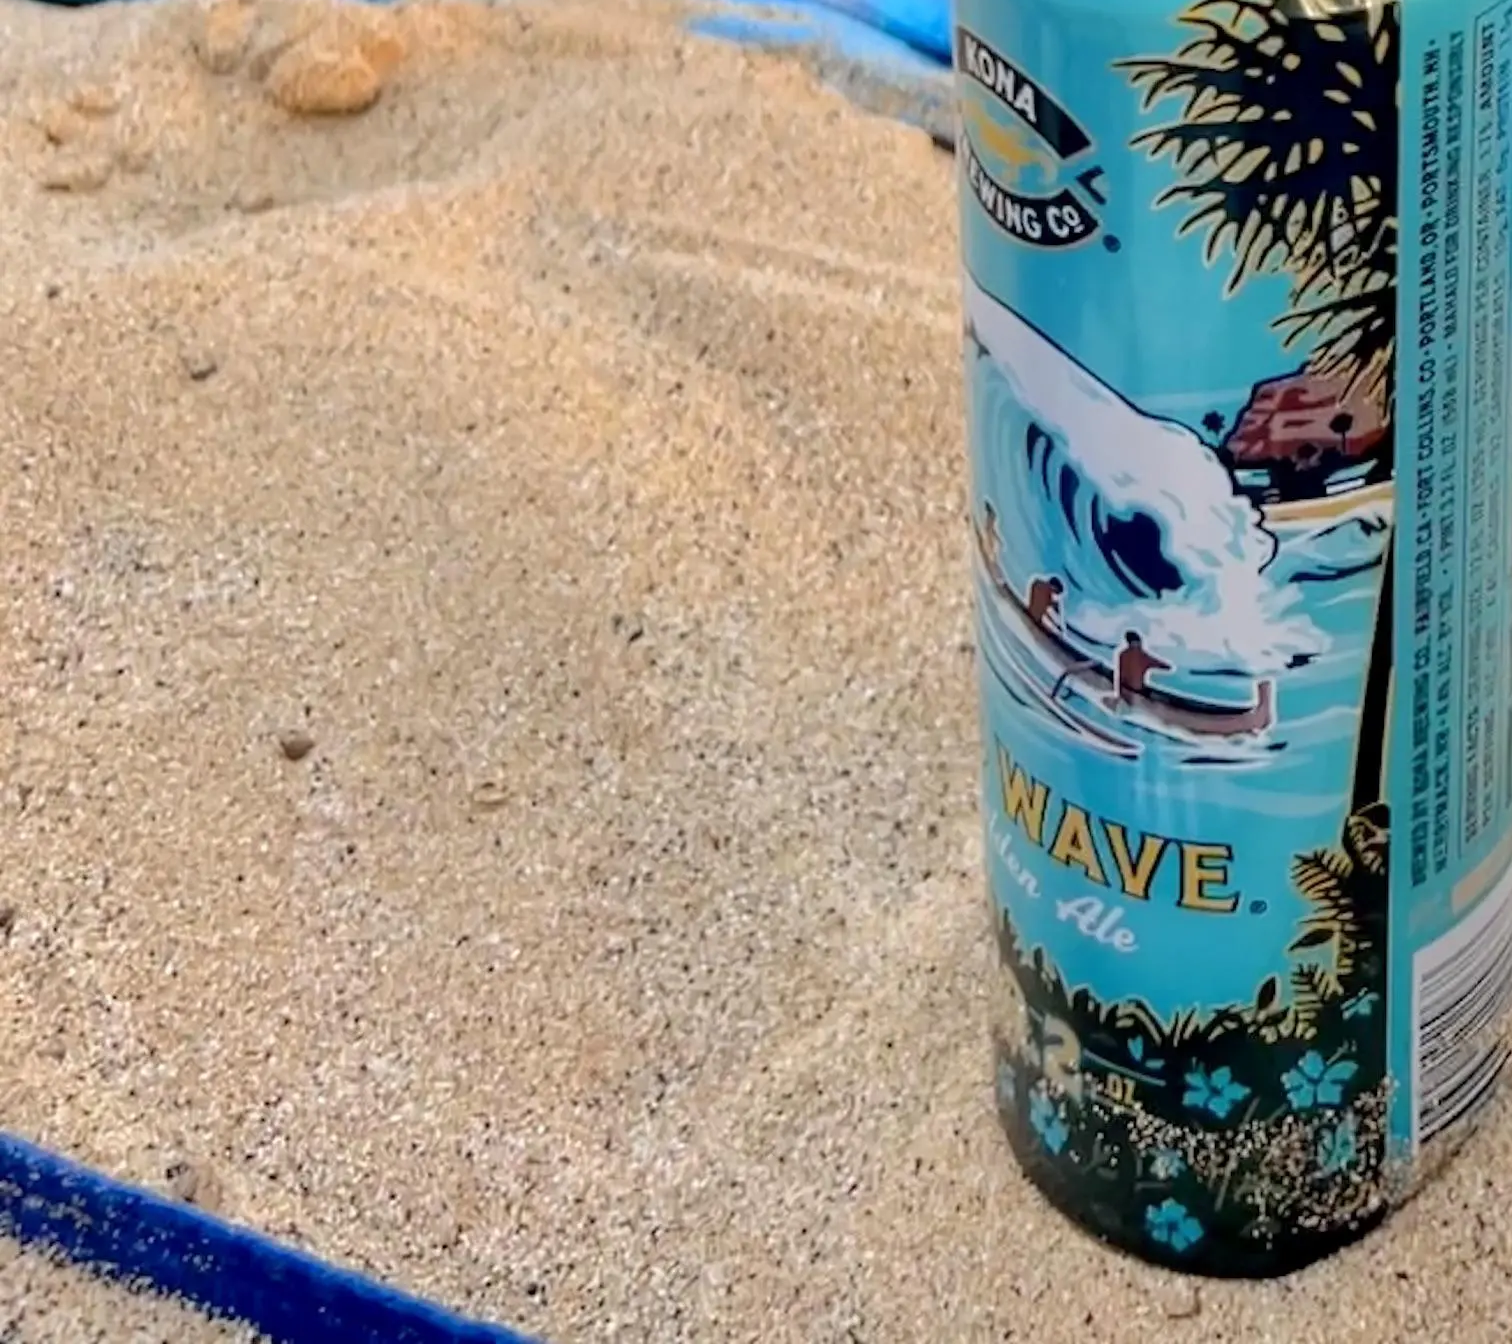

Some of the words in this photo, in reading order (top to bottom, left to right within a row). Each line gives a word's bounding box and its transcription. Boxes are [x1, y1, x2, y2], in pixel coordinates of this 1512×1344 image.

[962, 33, 1038, 124] KONA
[1480, 22, 1495, 111] AMOUNT
[994, 732, 1241, 914] WAVE
[1054, 895, 1139, 953] Ale
